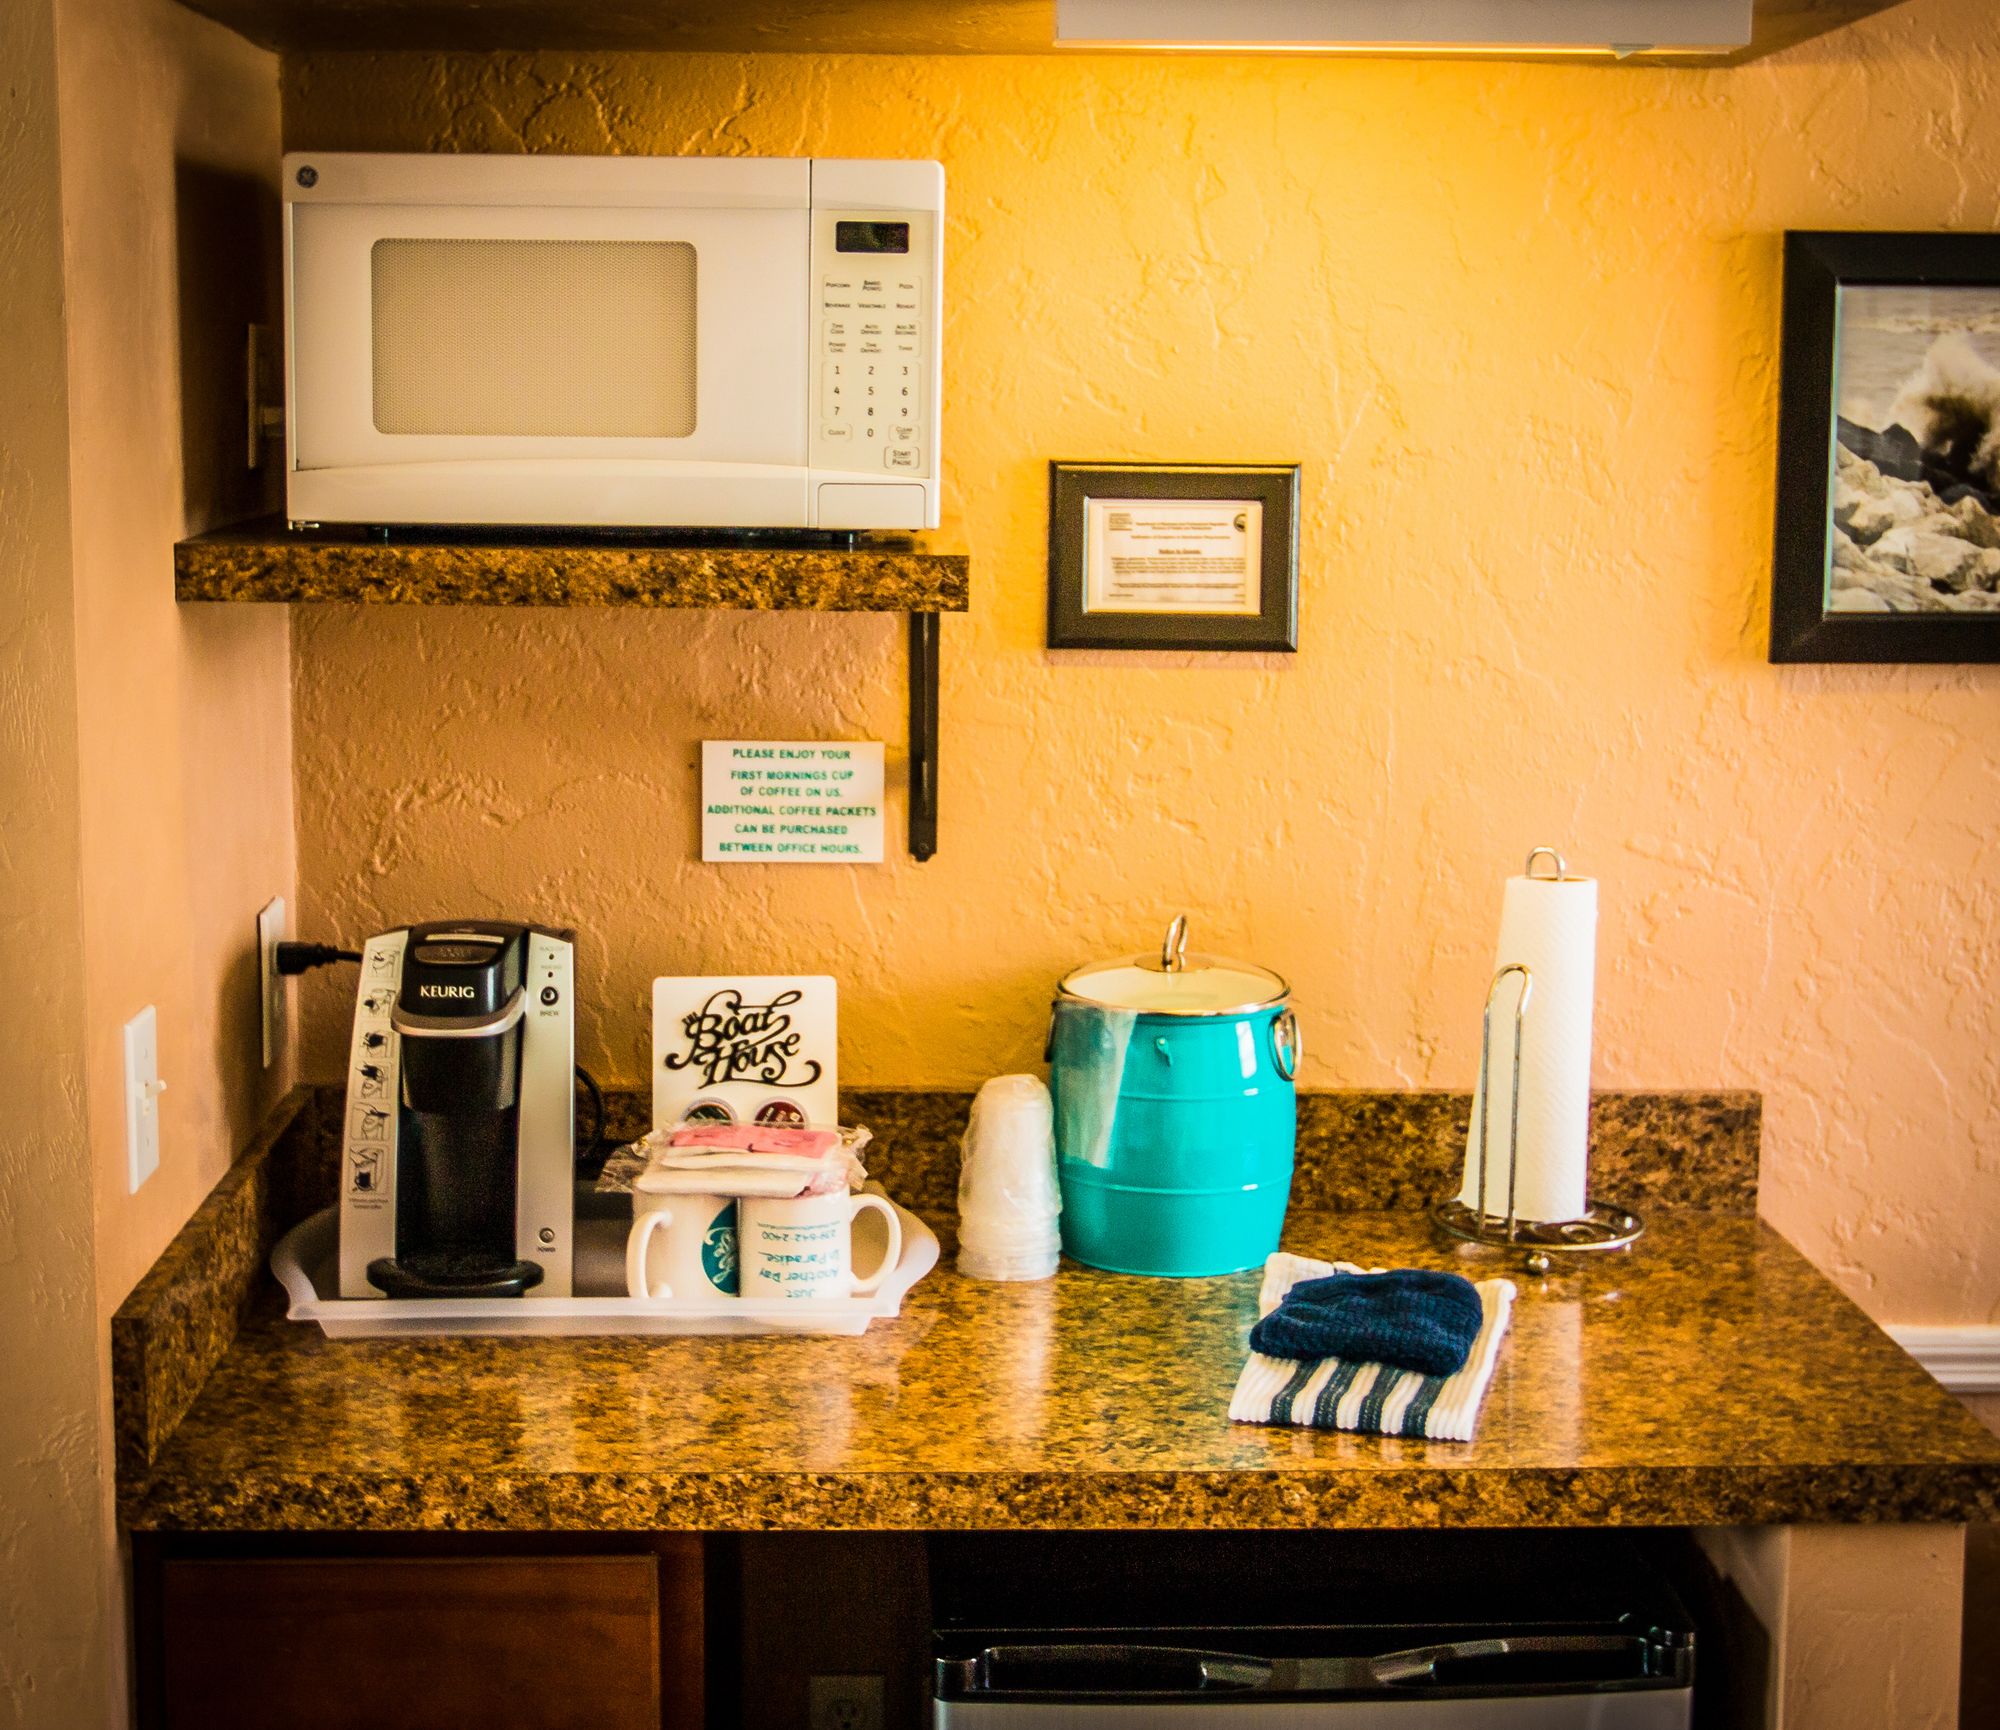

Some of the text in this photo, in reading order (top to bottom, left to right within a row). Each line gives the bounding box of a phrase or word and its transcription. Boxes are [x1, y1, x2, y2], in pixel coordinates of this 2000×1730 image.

[835, 366, 840, 375] 1
[868, 366, 874, 375] 2
[903, 366, 908, 376] 3
[834, 386, 840, 395] 4
[868, 387, 874, 396] 5
[902, 387, 908, 396] 6
[834, 406, 840, 415] 7
[867, 407, 874, 416] 8
[901, 408, 908, 417] 9
[733, 749, 850, 759] PLEASE ENJOY YOUR
[730, 770, 854, 780] FIRST MORNINGS CUP
[740, 787, 754, 796] OF
[759, 787, 800, 796] COFFEE
[806, 787, 821, 797] ON
[707, 805, 876, 816] ADDITIONAL COFFEE PACKETS
[735, 824, 848, 835] CAN BE PURCHASED
[719, 842, 863, 854] BETWEEN OFFICE HOURS.
[420, 985, 475, 999] KEURIG
[693, 1014, 822, 1089] House
